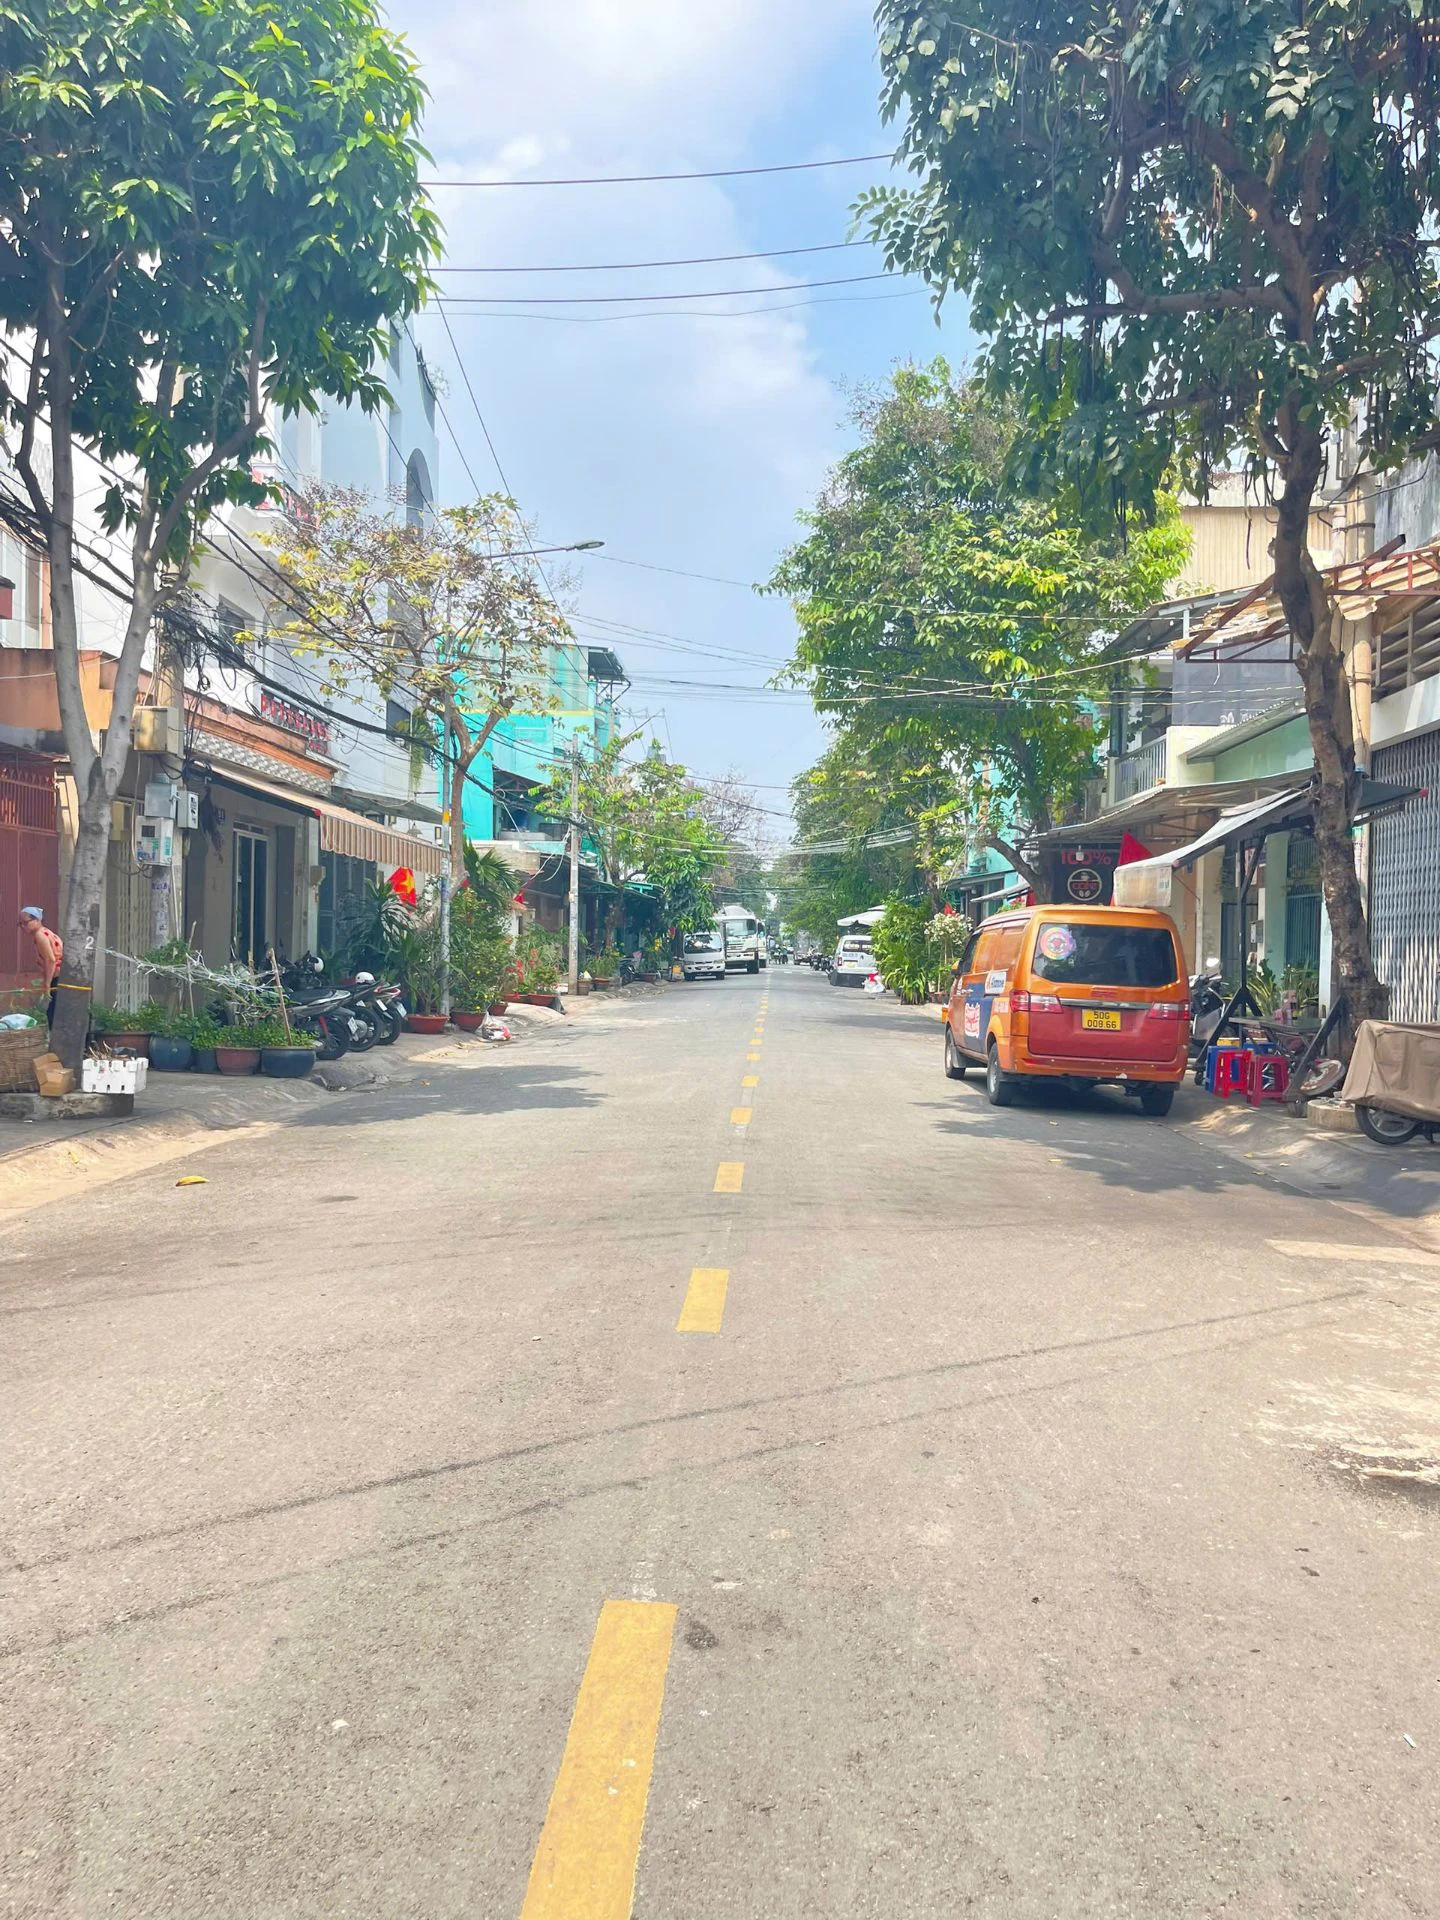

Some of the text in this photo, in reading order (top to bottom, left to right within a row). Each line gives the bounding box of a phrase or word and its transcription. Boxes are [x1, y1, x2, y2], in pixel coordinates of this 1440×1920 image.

[1061, 849, 1112, 865] 100%
[85, 935, 95, 950] 2
[1093, 1011, 1110, 1020] 50G
